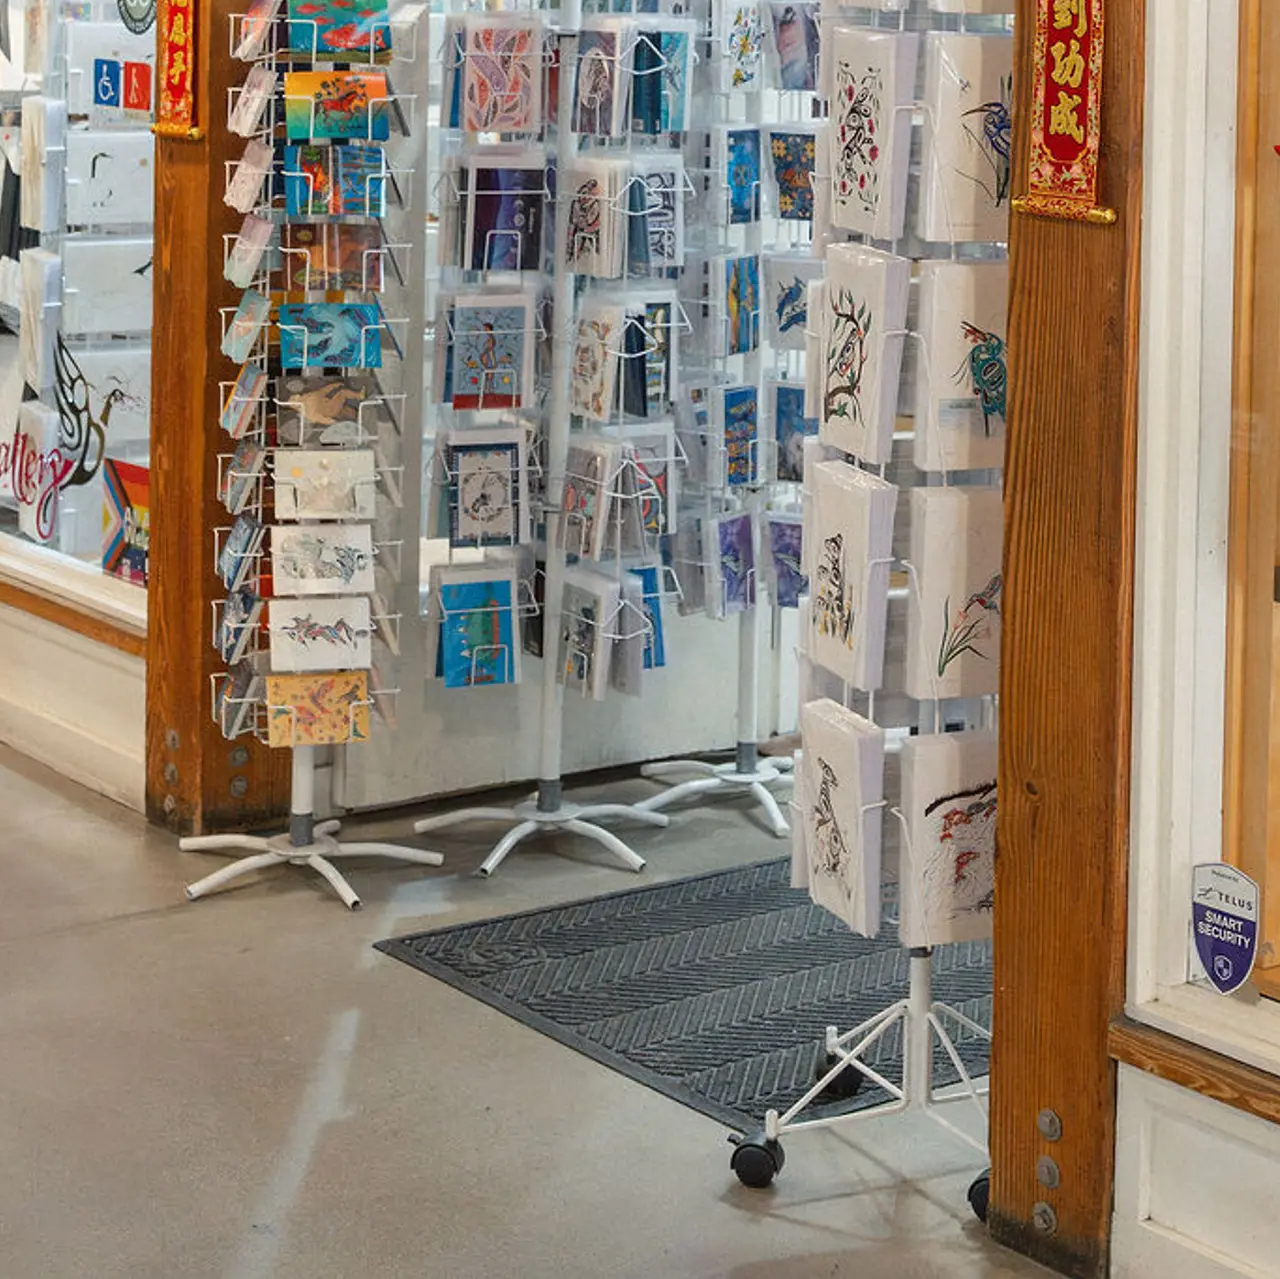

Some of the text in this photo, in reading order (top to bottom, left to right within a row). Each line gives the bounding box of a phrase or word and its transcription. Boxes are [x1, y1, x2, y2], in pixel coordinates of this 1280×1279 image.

[1218, 891, 1253, 912] TELUS
[1205, 909, 1244, 933] SMART
[1197, 920, 1251, 949] SECURITY
